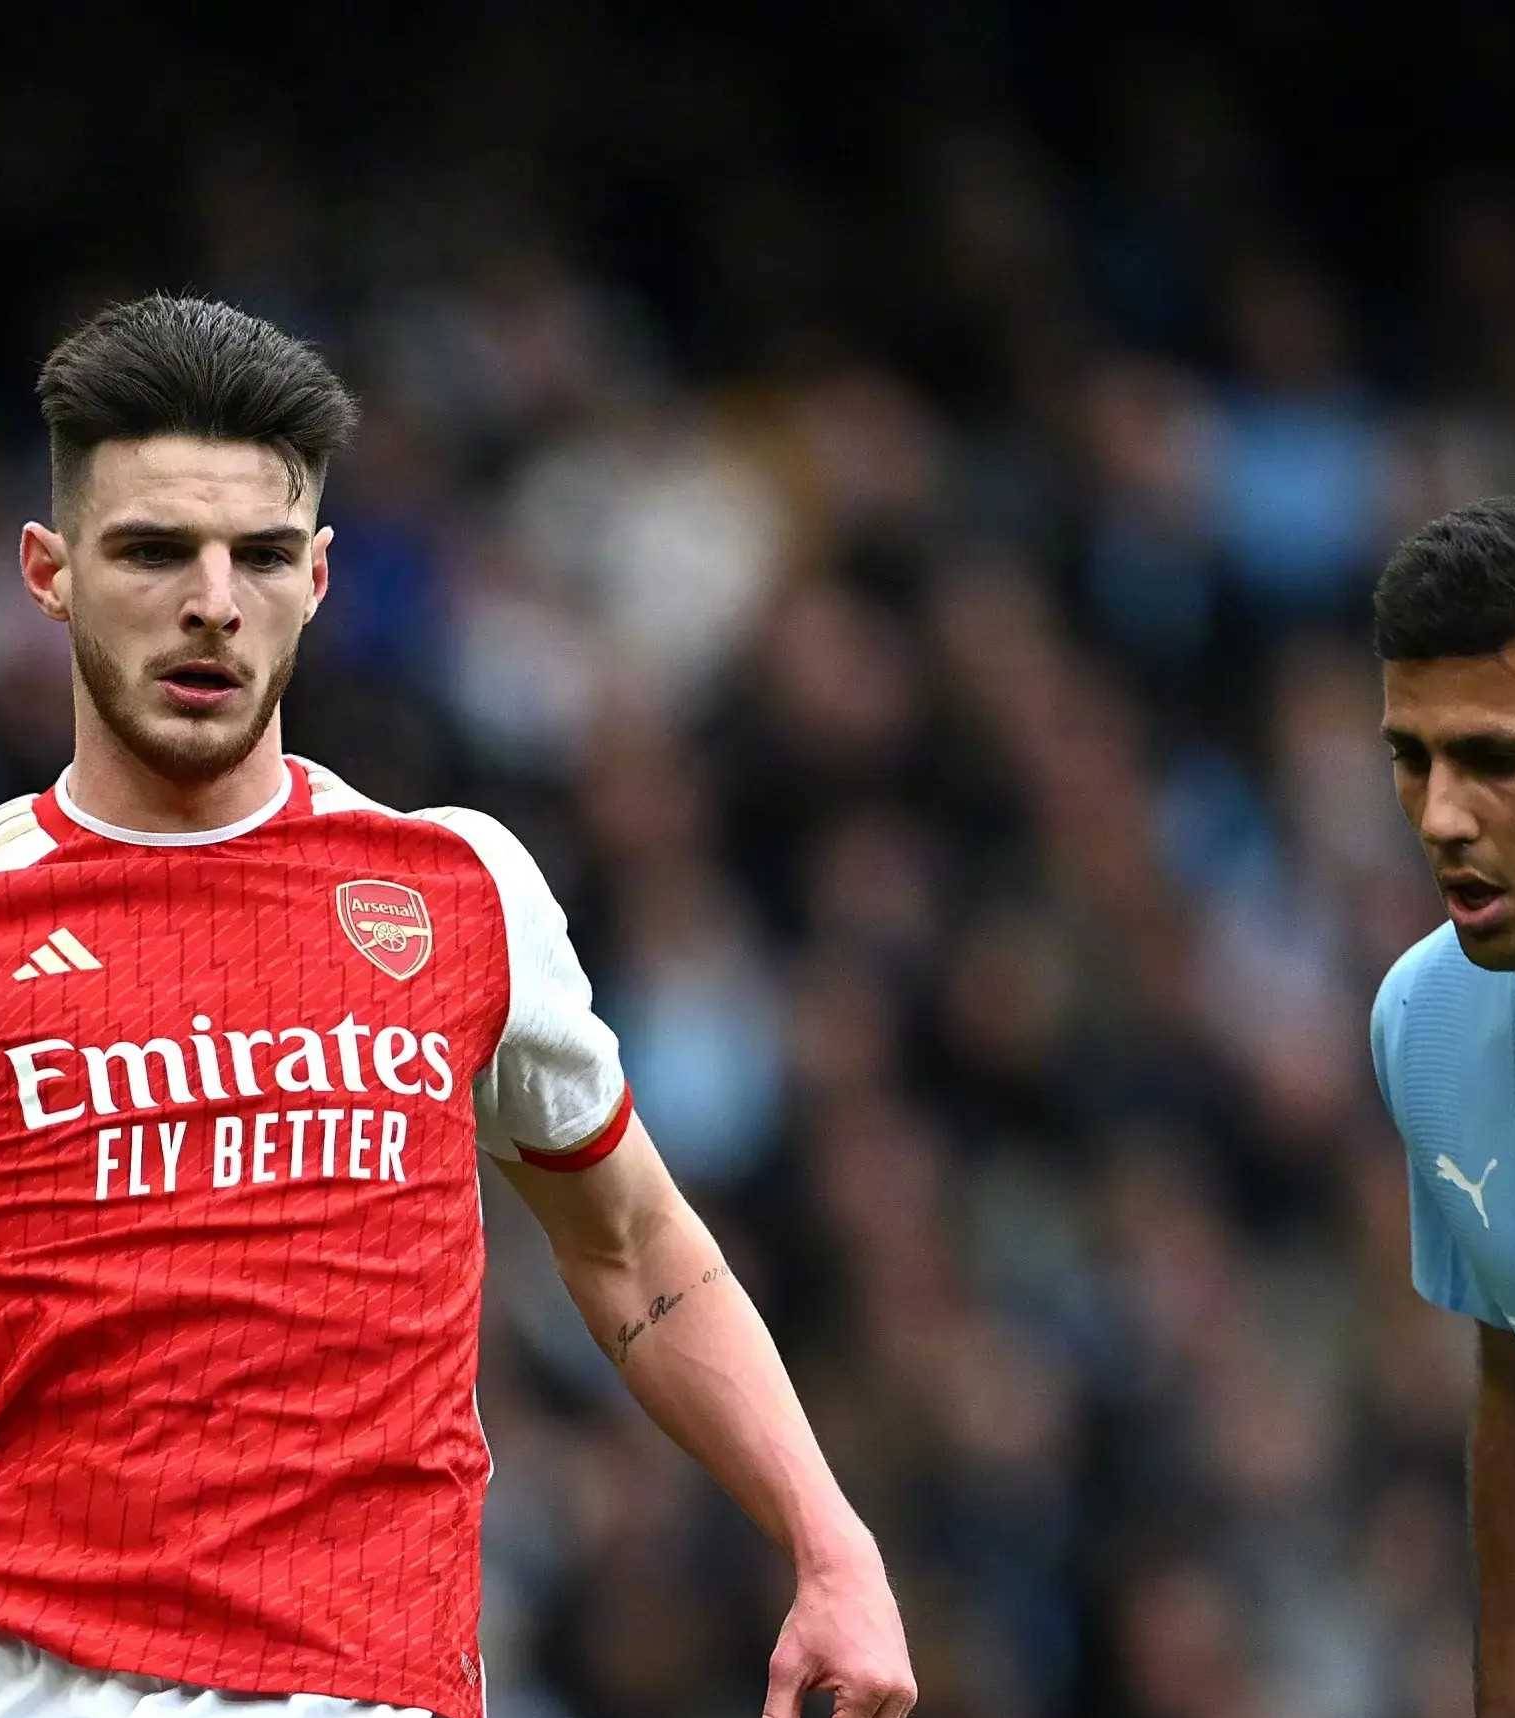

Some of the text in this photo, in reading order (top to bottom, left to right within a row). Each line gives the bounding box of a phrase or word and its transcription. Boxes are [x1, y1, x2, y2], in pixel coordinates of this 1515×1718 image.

[351, 897, 415, 918] Arsenal
[4, 1012, 454, 1131] Emirates
[95, 1109, 409, 1200] FLY BETTER
